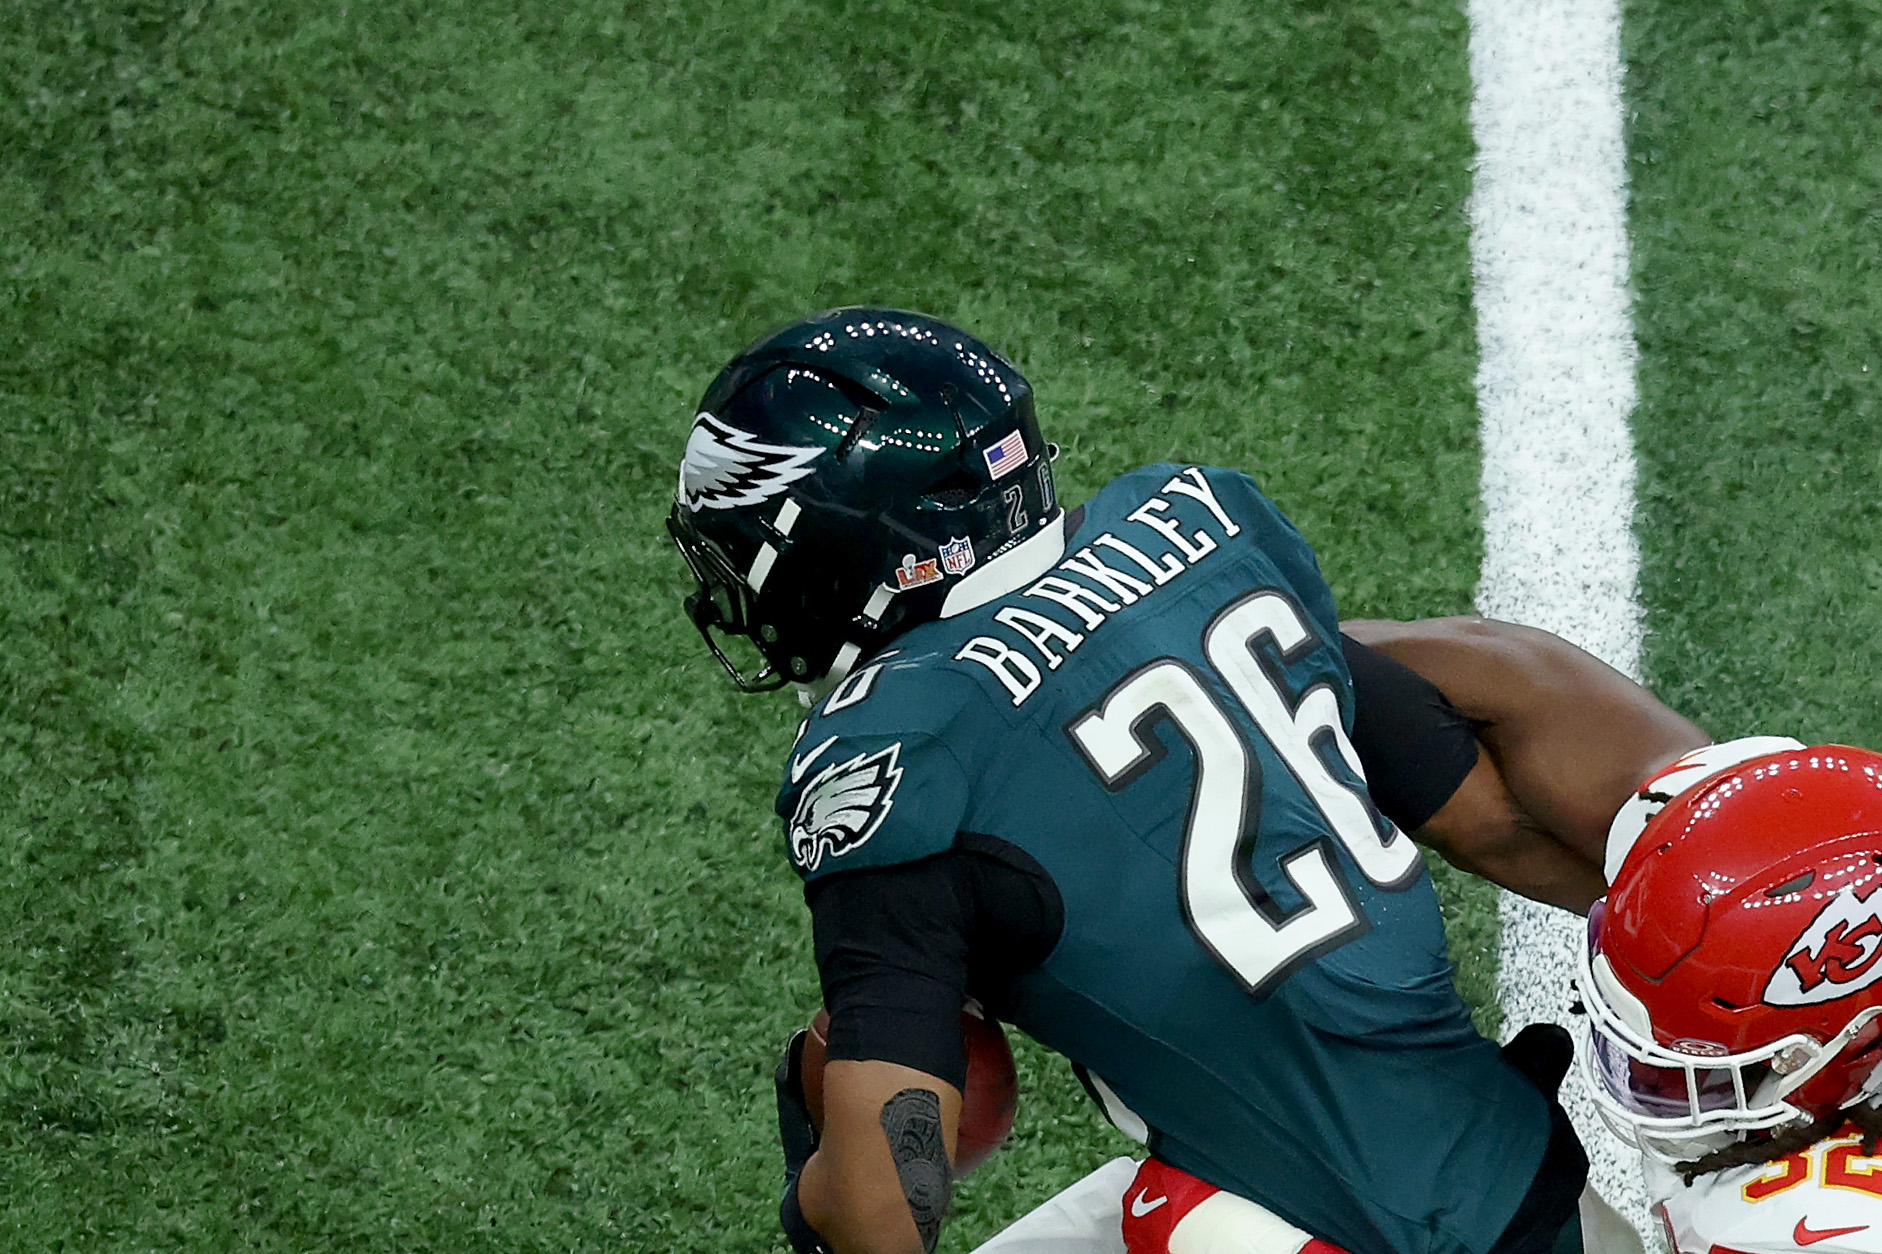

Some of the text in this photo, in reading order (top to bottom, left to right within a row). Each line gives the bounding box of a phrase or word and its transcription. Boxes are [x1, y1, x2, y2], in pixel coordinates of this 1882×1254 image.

[946, 551, 972, 570] NFL
[1003, 462, 1053, 534] 26
[954, 465, 1242, 708] BARKLEY
[1062, 584, 1426, 1000] 26
